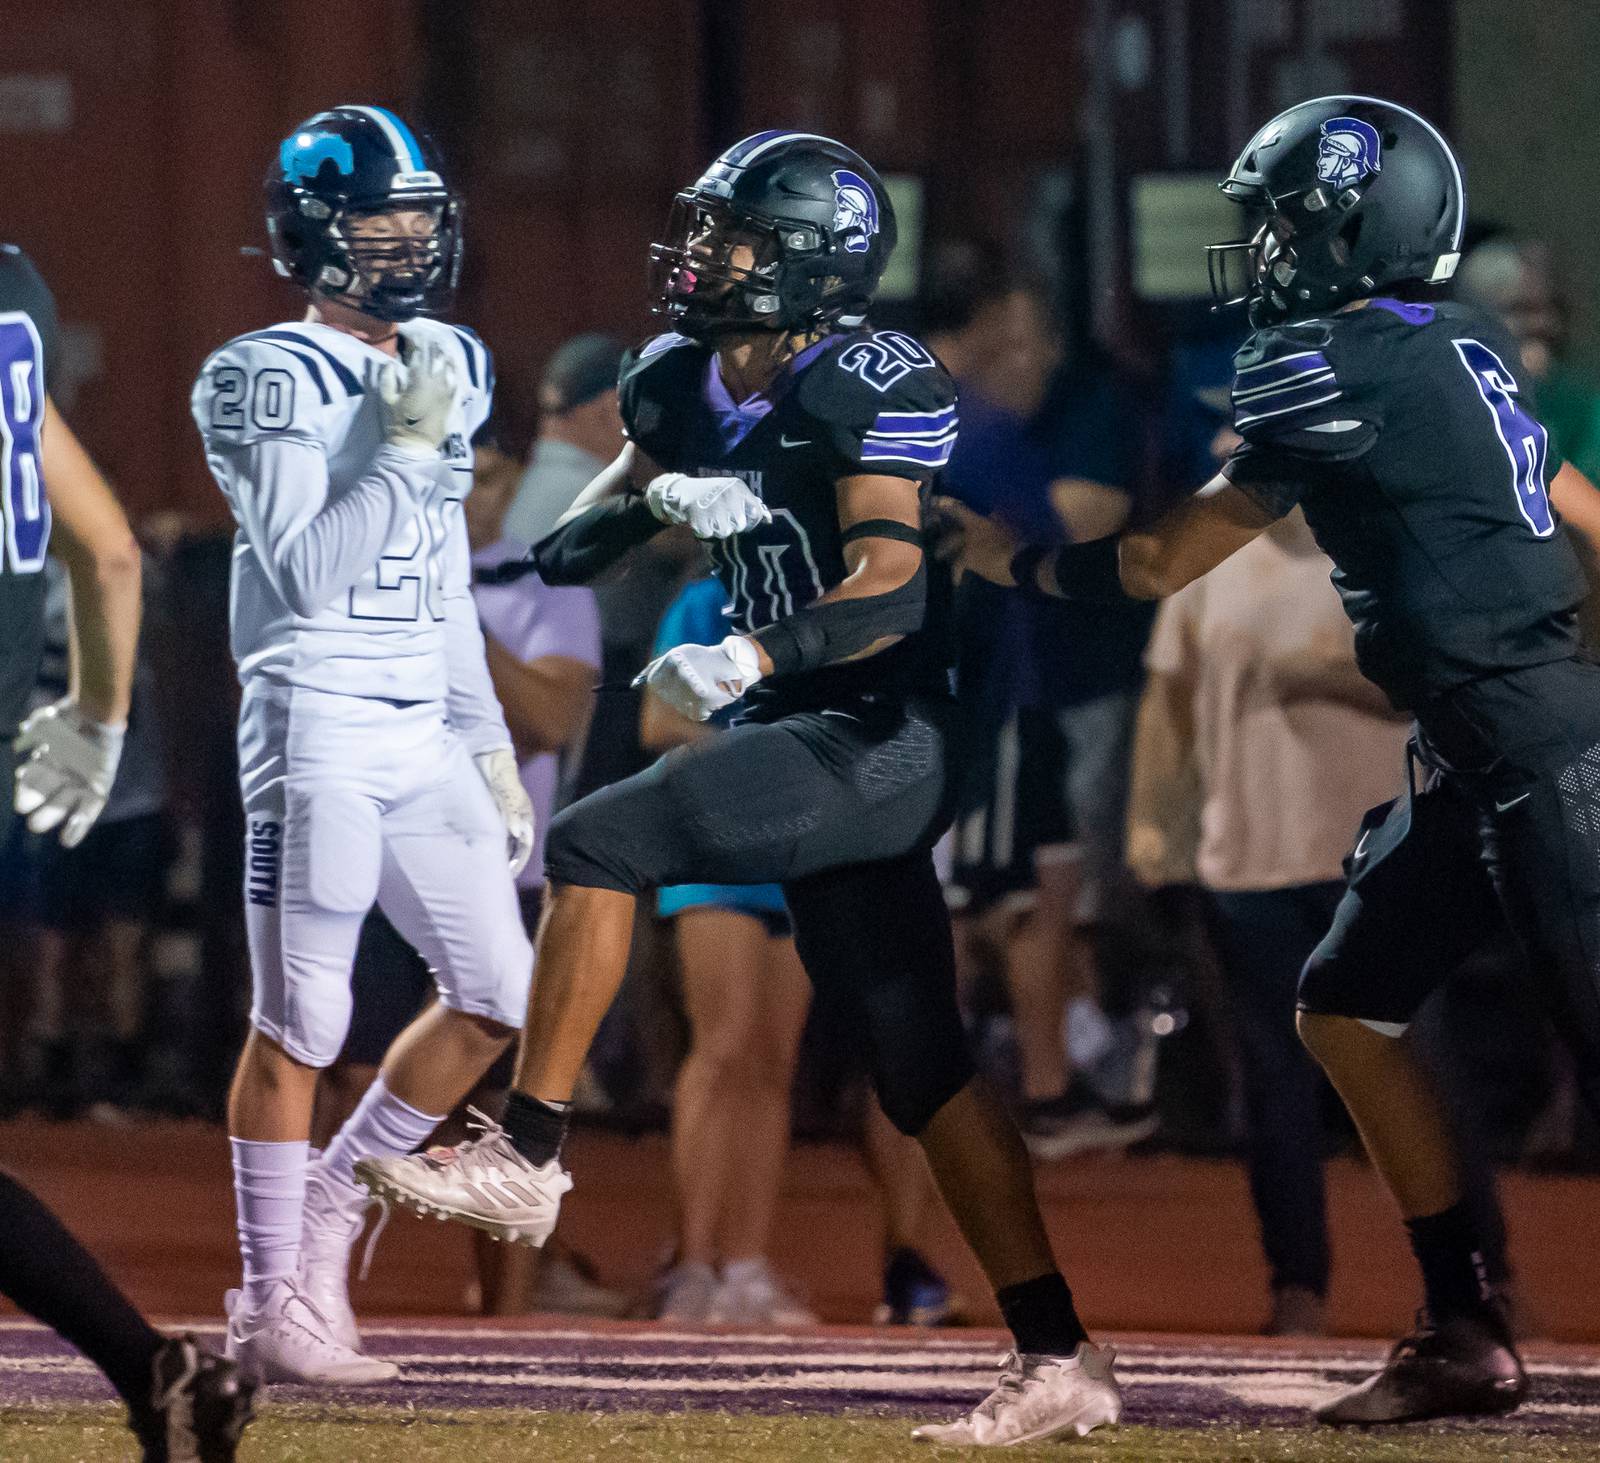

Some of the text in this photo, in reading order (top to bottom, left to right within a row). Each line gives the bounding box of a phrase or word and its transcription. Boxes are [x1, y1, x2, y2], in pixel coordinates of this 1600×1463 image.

[211, 366, 295, 431] 20
[839, 330, 936, 393] 20
[0, 311, 52, 574] 8
[1451, 338, 1555, 537] 6
[248, 820, 281, 908] SOUTH
